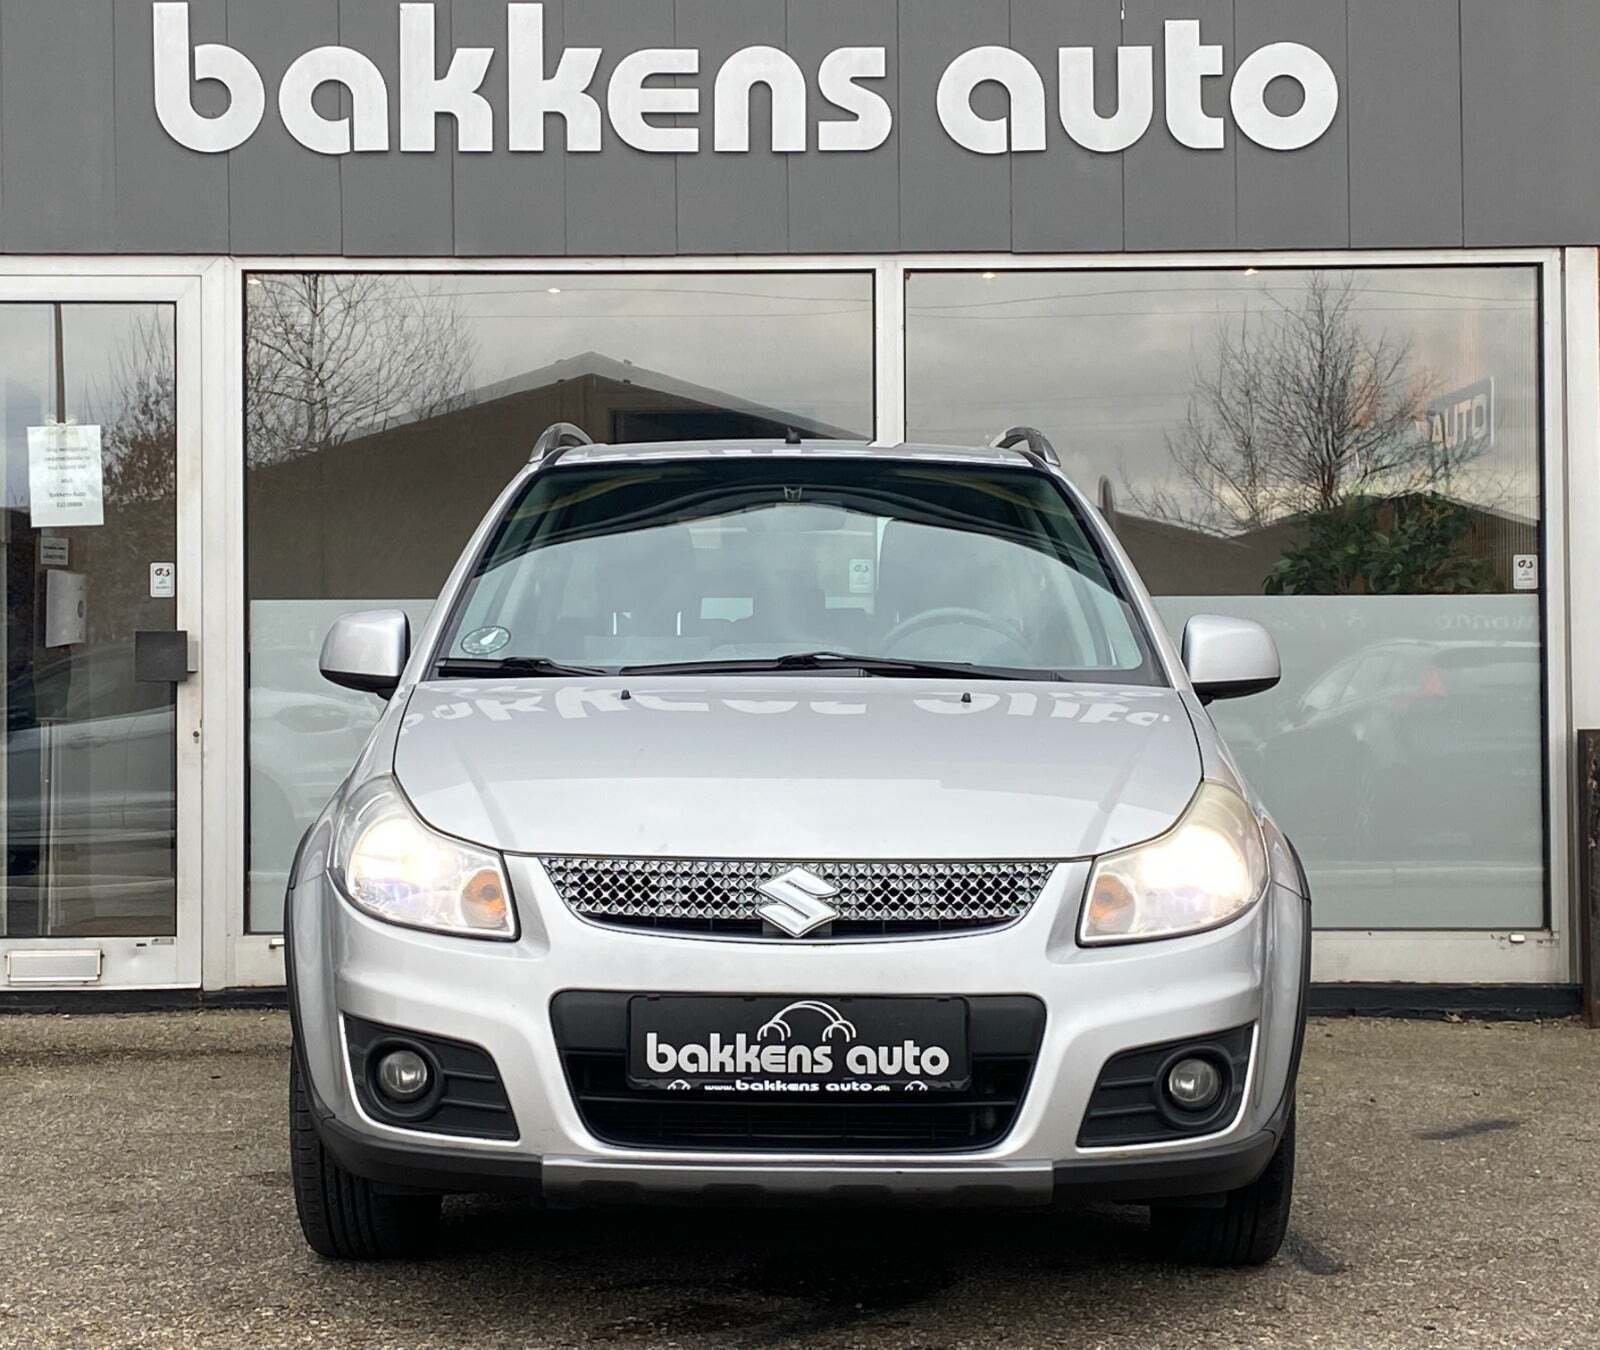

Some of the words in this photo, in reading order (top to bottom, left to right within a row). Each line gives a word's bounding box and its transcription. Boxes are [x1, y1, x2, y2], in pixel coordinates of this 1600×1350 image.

[153, 2, 892, 154] bakkens
[937, 19, 1338, 154] auto
[646, 1032, 833, 1075] bakkens
[846, 1040, 950, 1076] auto
